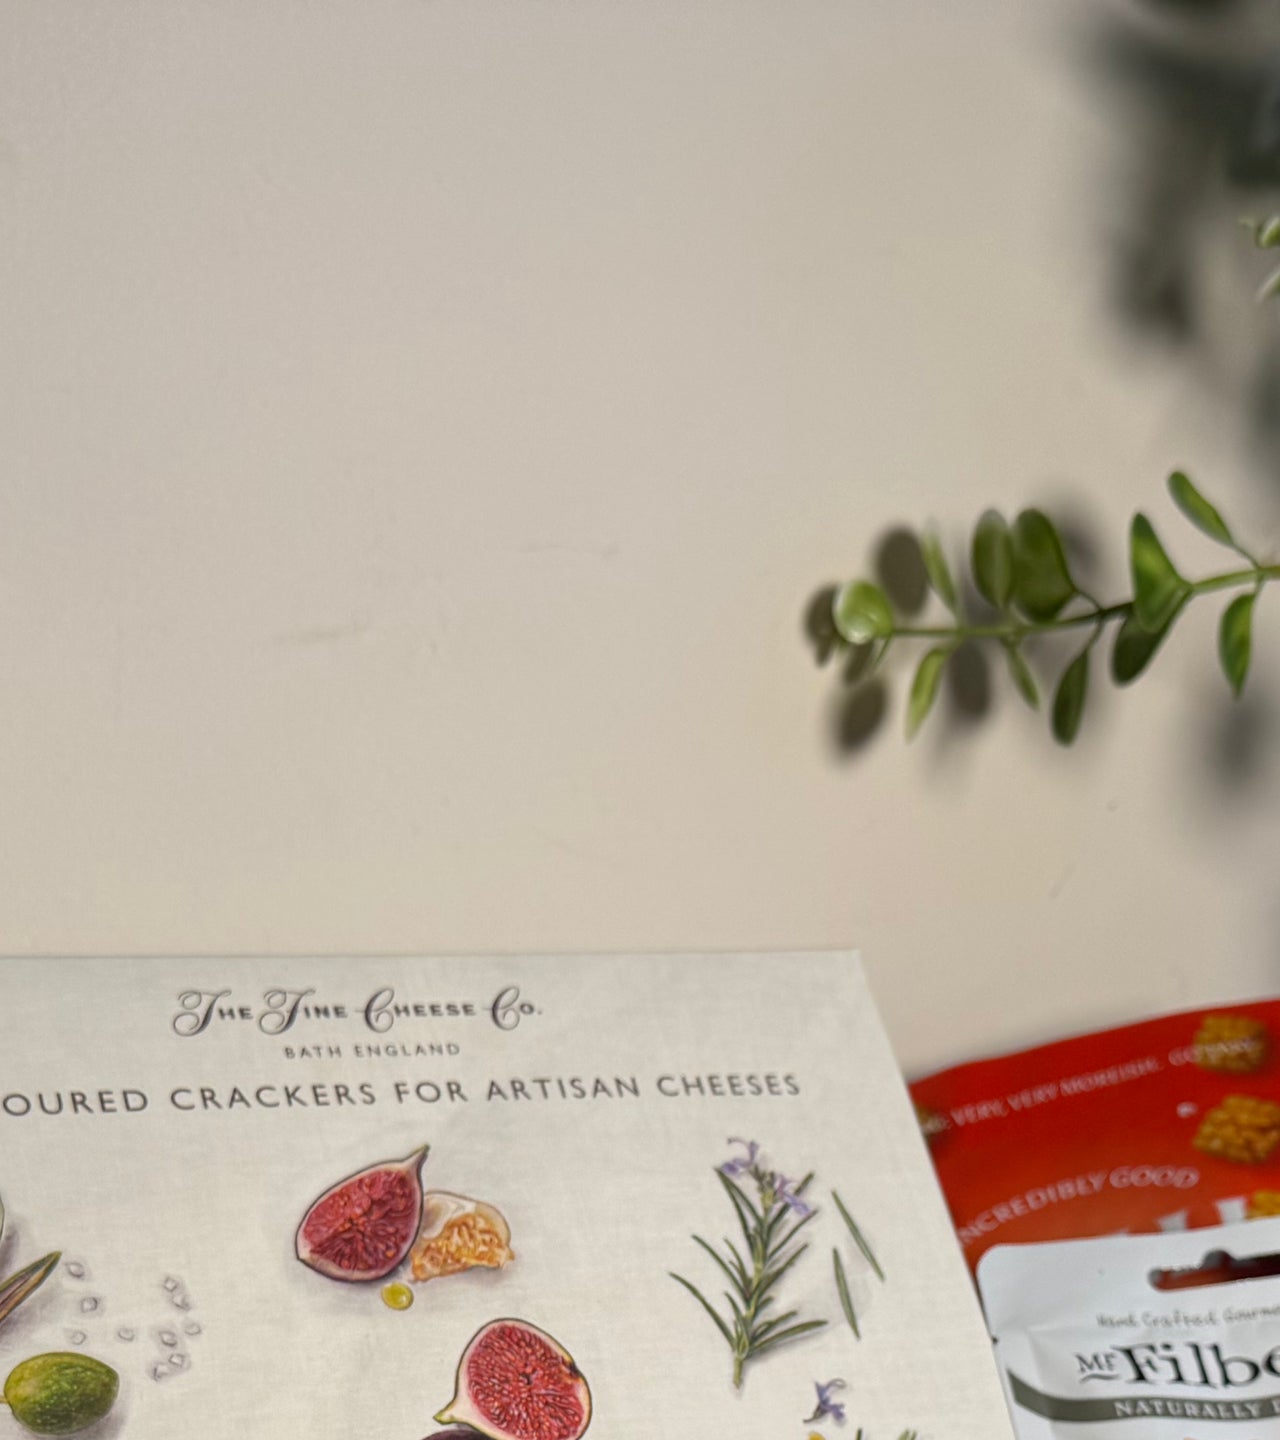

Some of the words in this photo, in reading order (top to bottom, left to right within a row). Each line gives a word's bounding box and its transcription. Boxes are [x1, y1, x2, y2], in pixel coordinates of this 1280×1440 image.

[283, 1044, 342, 1060] BATH
[354, 1042, 461, 1058] ENGLAND
[170, 1082, 375, 1111] CRACKERS
[394, 1080, 469, 1104] FOR
[486, 1076, 641, 1102] ARTISAN
[656, 1072, 801, 1098] CHEESES
[1109, 1164, 1200, 1190] GOOD
[1113, 1399, 1264, 1420] NATURALLY
